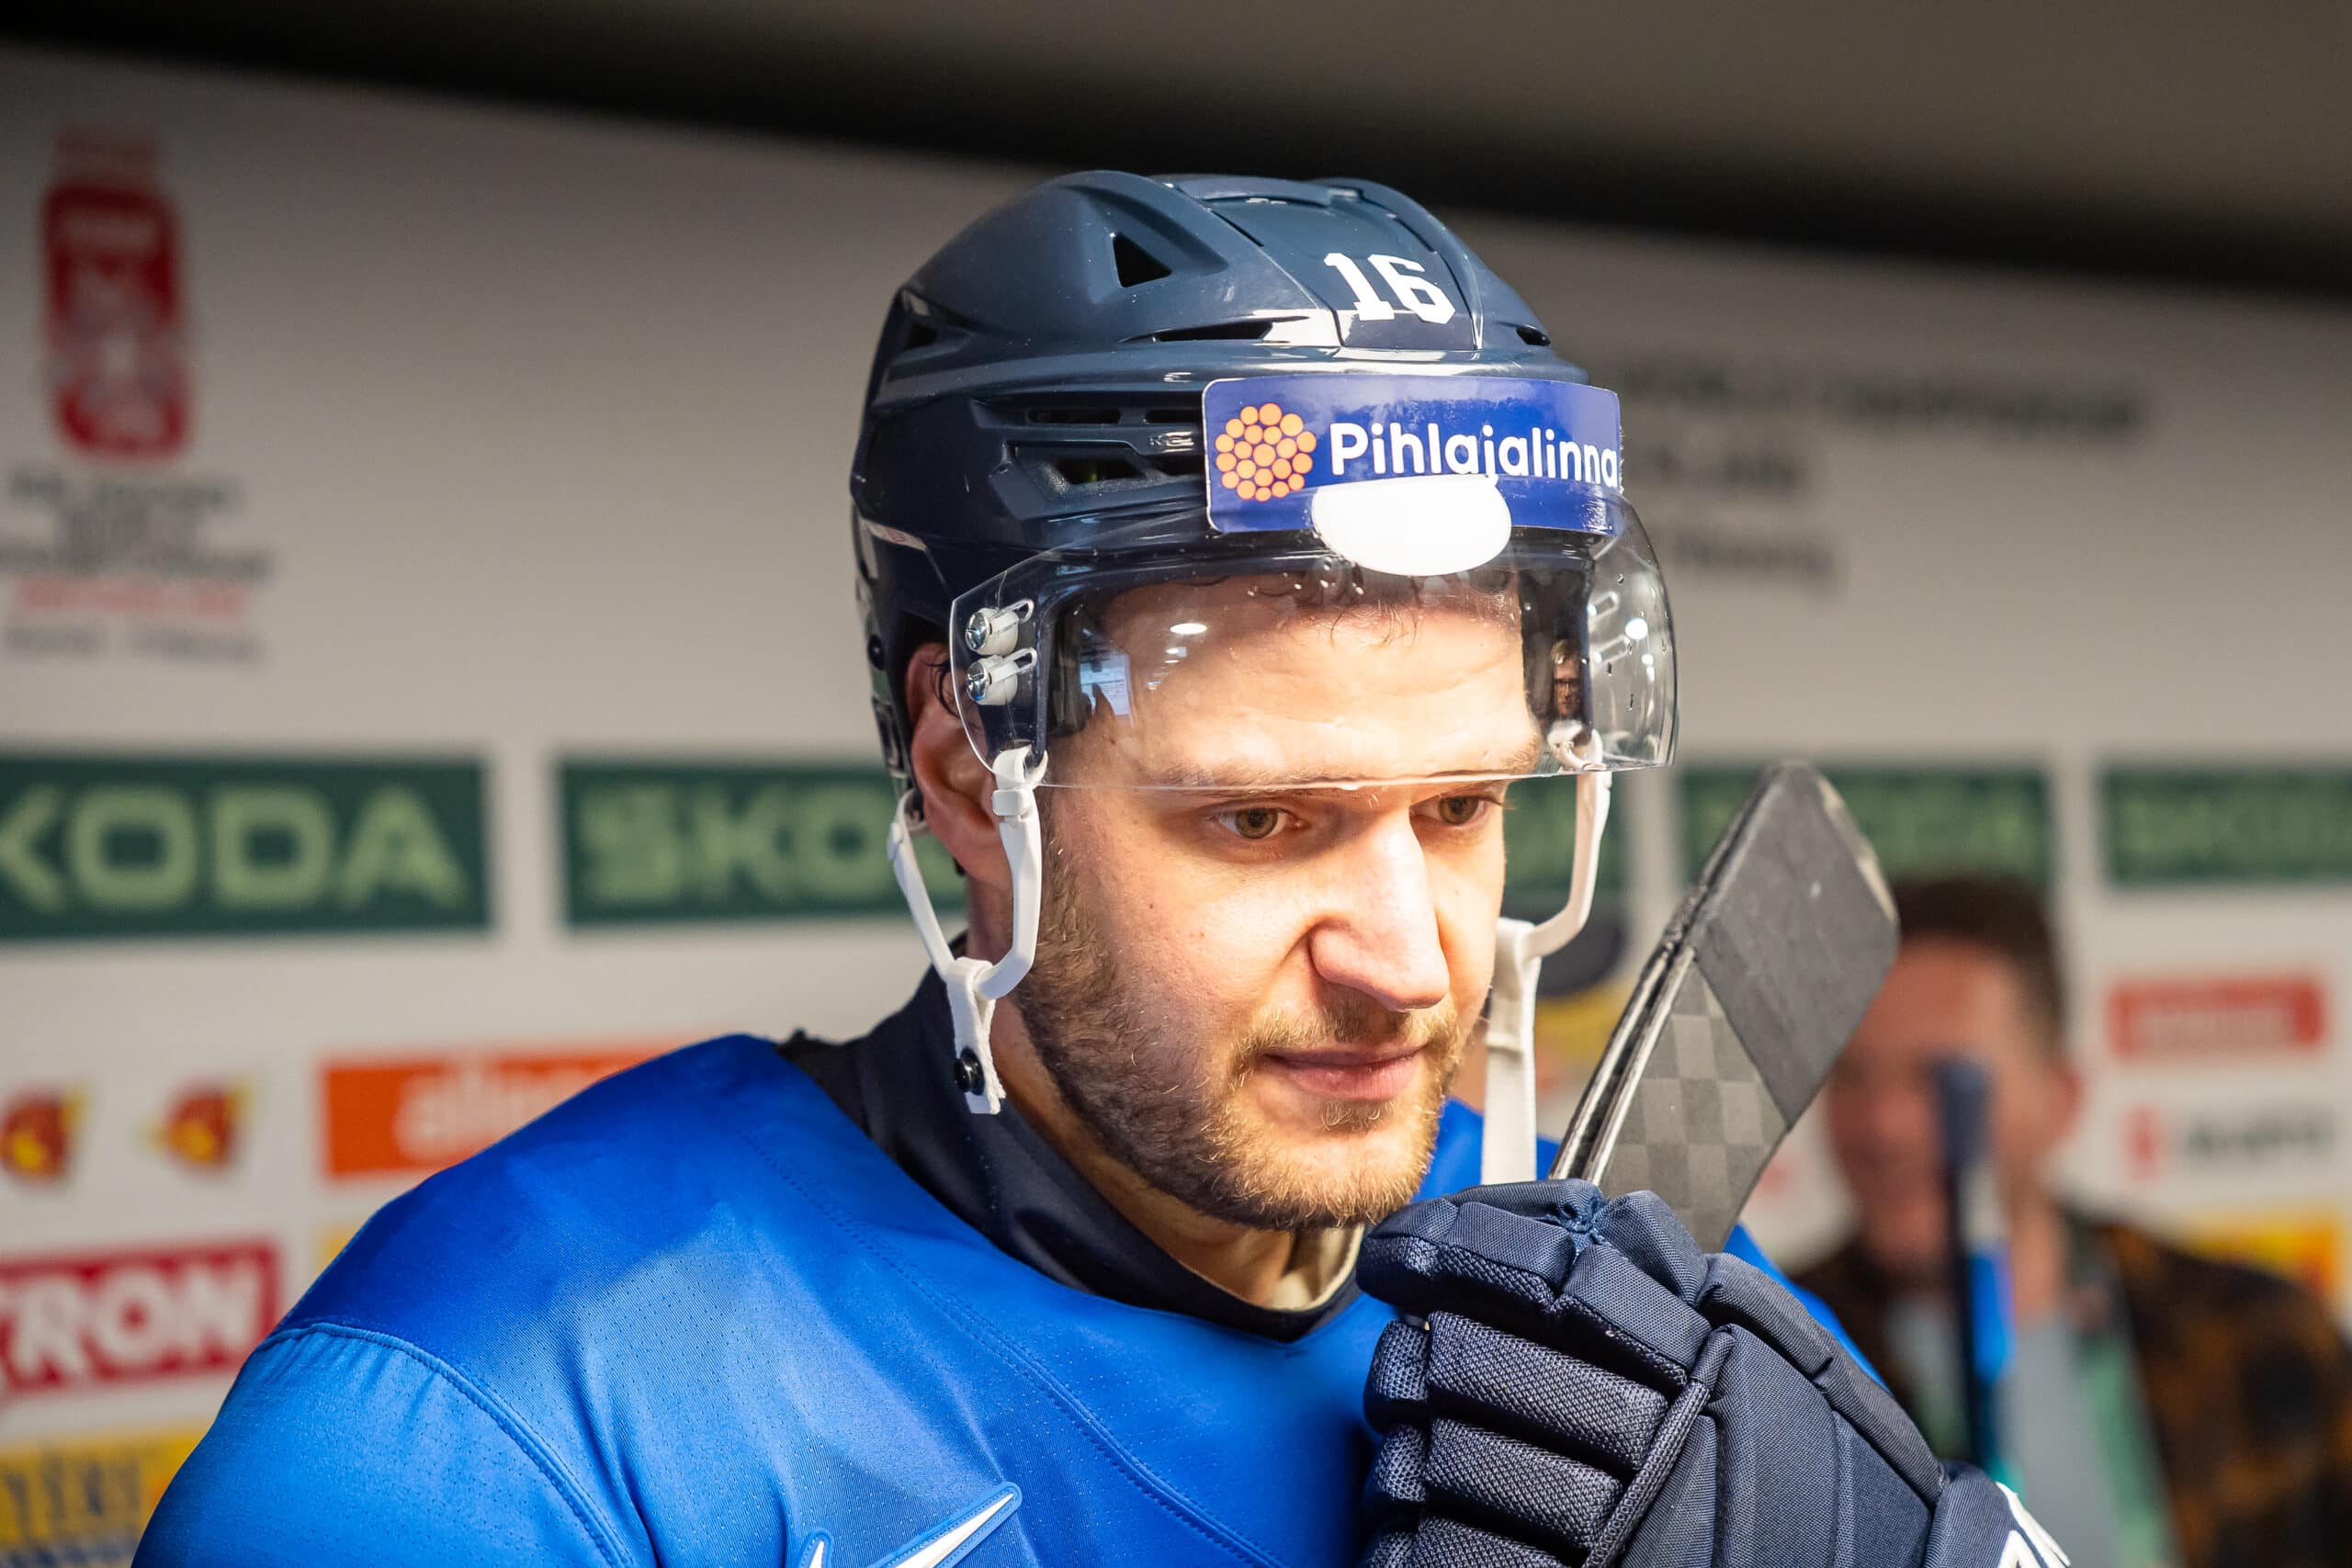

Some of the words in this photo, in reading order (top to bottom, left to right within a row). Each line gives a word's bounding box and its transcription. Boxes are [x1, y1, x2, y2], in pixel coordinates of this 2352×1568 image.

[1324, 253, 1455, 325] 16
[1329, 423, 1620, 488] Pihlajalinna
[0, 1263, 260, 1380] RON
